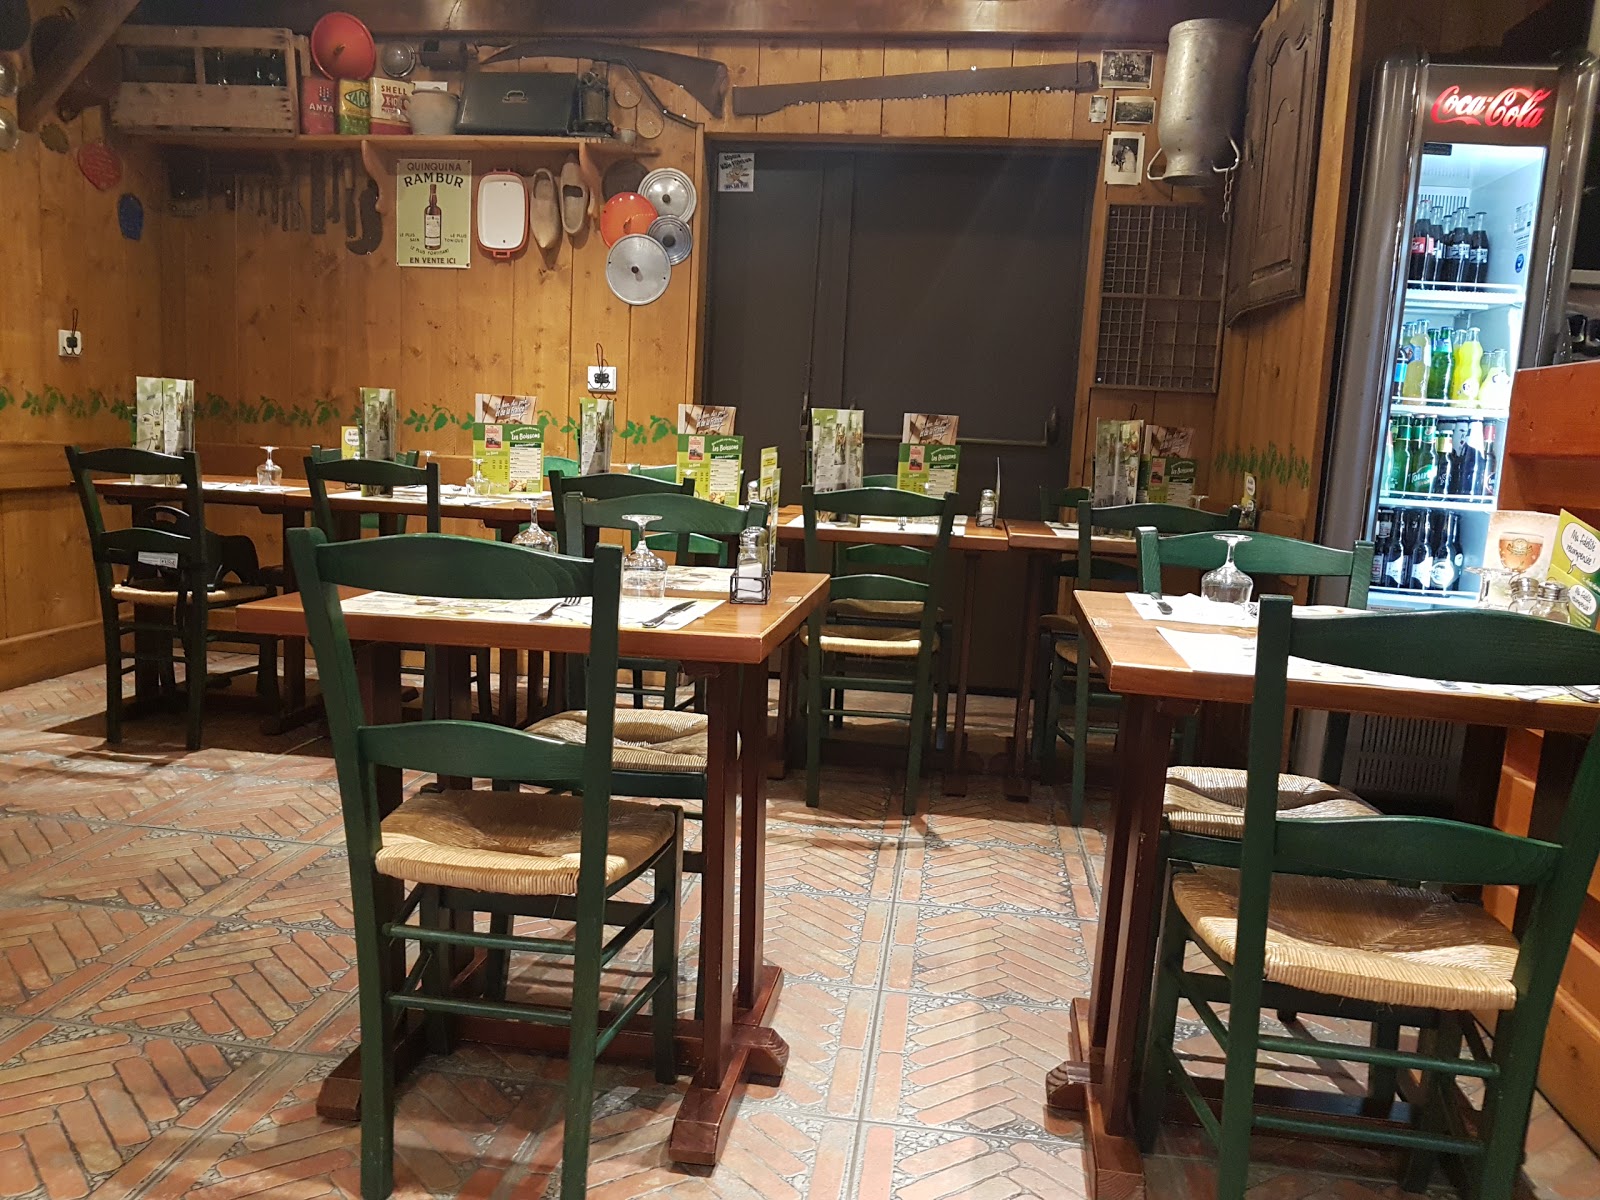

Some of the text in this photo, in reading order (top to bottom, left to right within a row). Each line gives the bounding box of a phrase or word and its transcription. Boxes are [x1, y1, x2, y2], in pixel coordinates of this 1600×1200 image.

[381, 84, 407, 96] SHELL
[1430, 85, 1551, 128] Coca-Cola
[407, 162, 462, 172] QUINQUINA
[403, 172, 464, 188] RAMBUR
